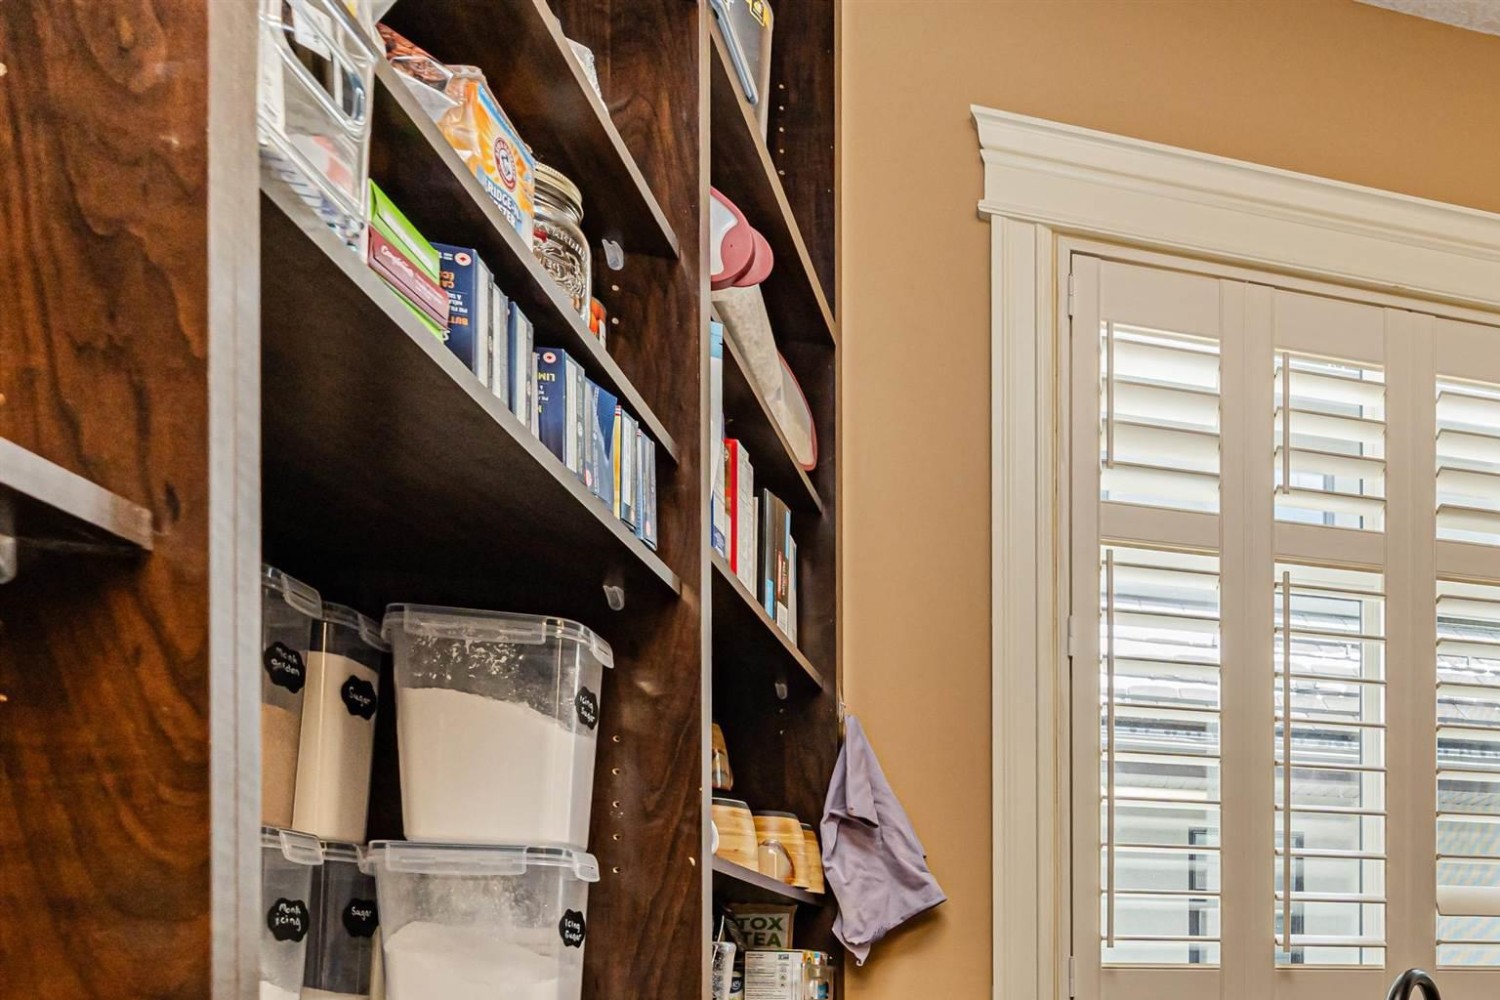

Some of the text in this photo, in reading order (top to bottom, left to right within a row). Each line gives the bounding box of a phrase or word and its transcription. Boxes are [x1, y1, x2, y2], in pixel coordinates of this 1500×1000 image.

[537, 372, 556, 382] LIM
[740, 916, 783, 931] TOX
[743, 931, 782, 948] TEA
